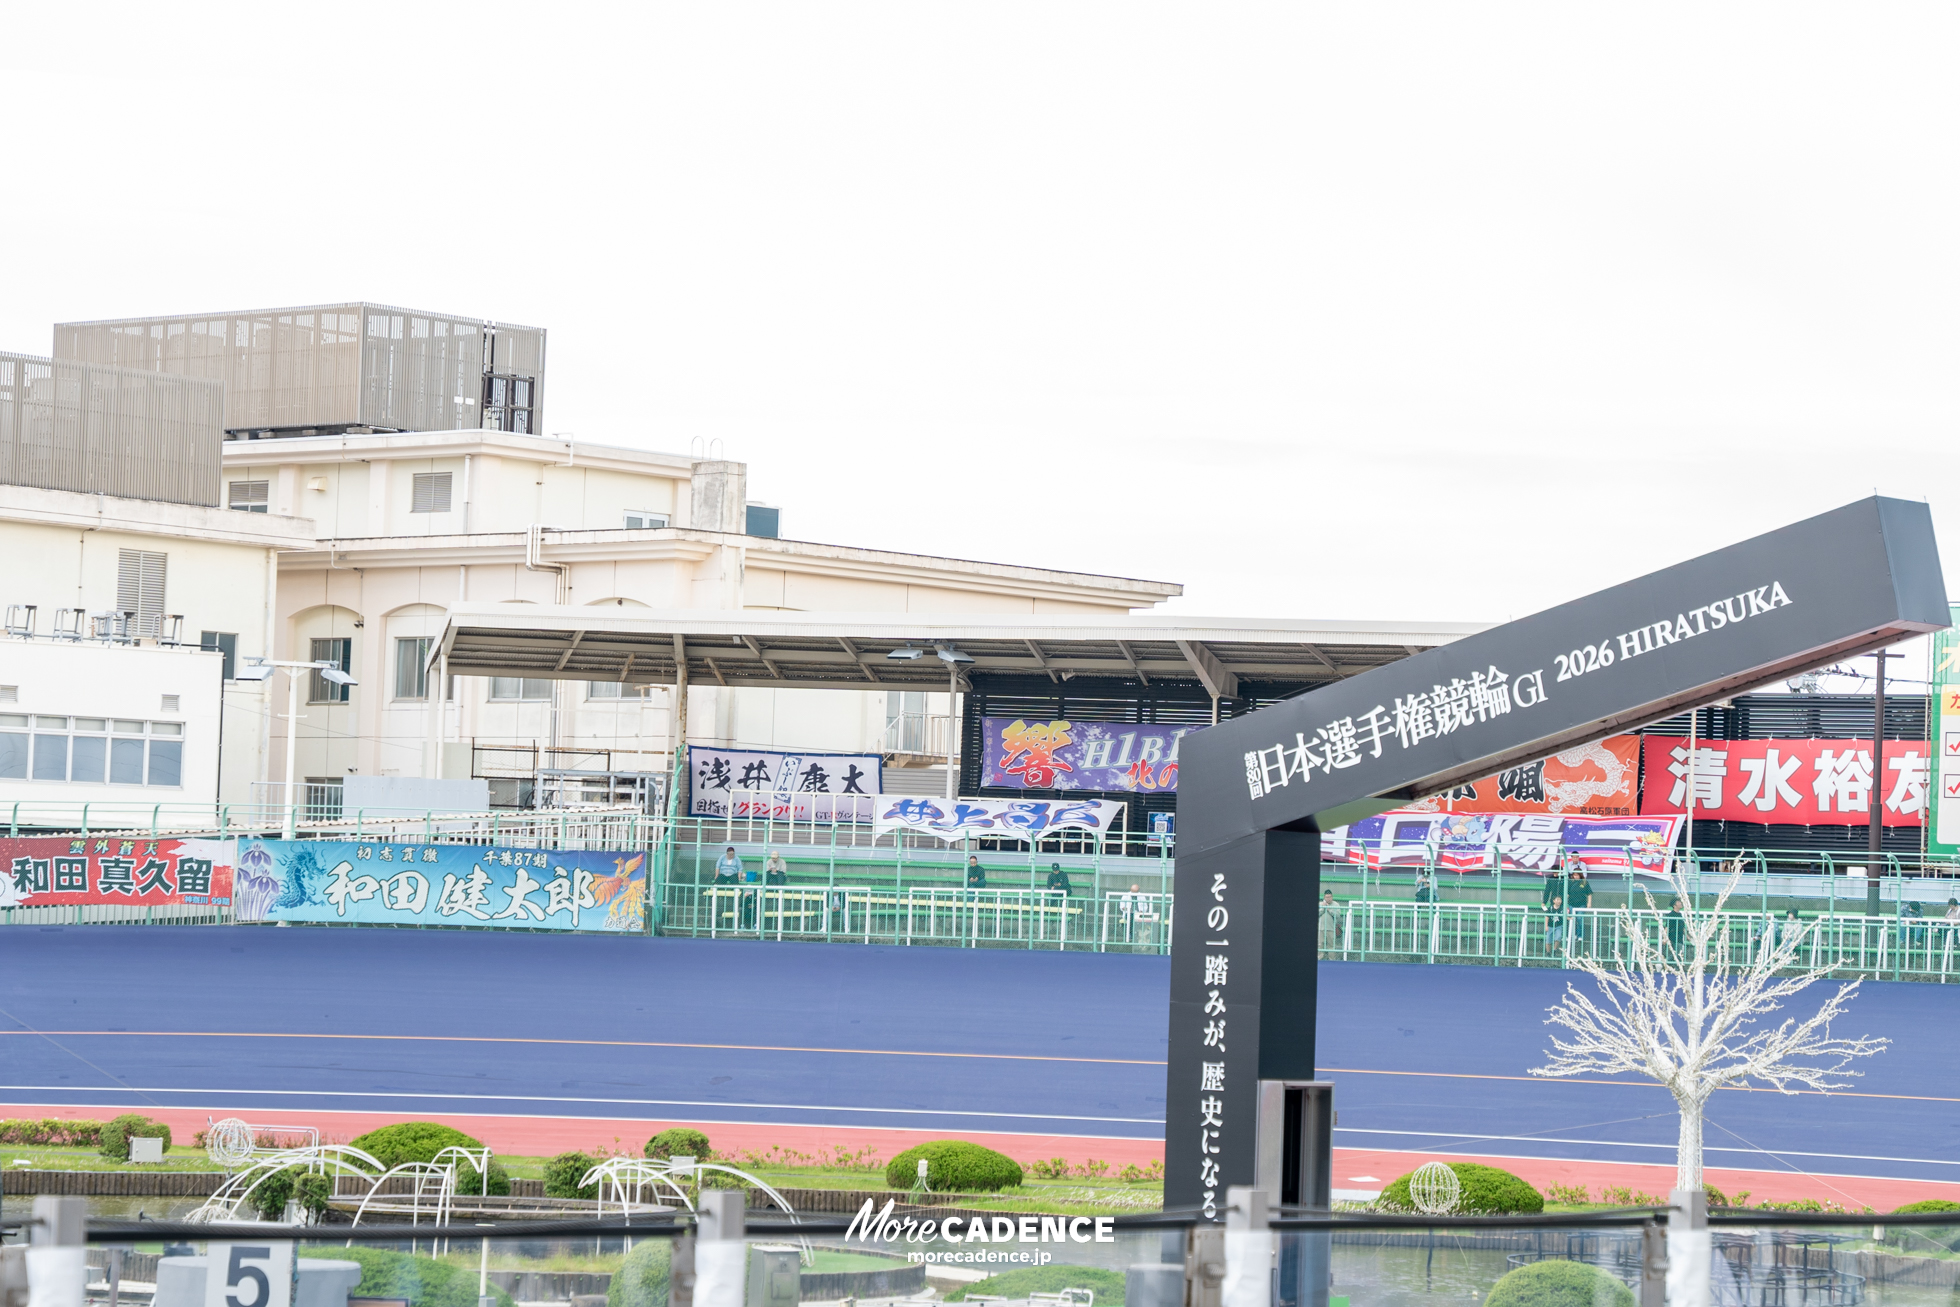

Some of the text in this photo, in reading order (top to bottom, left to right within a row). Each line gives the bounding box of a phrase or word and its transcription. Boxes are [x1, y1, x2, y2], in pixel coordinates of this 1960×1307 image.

[1553, 640, 1615, 683] 2026
[1616, 581, 1793, 662] HIRATSUKA
[698, 757, 772, 794] 浅井
[1667, 744, 1929, 816] 清水裕友
[68, 839, 159, 857] 雲外蒼天
[483, 850, 549, 869] 千葉87期
[323, 861, 597, 927] 和田健太郎
[226, 1246, 270, 1307] 5
